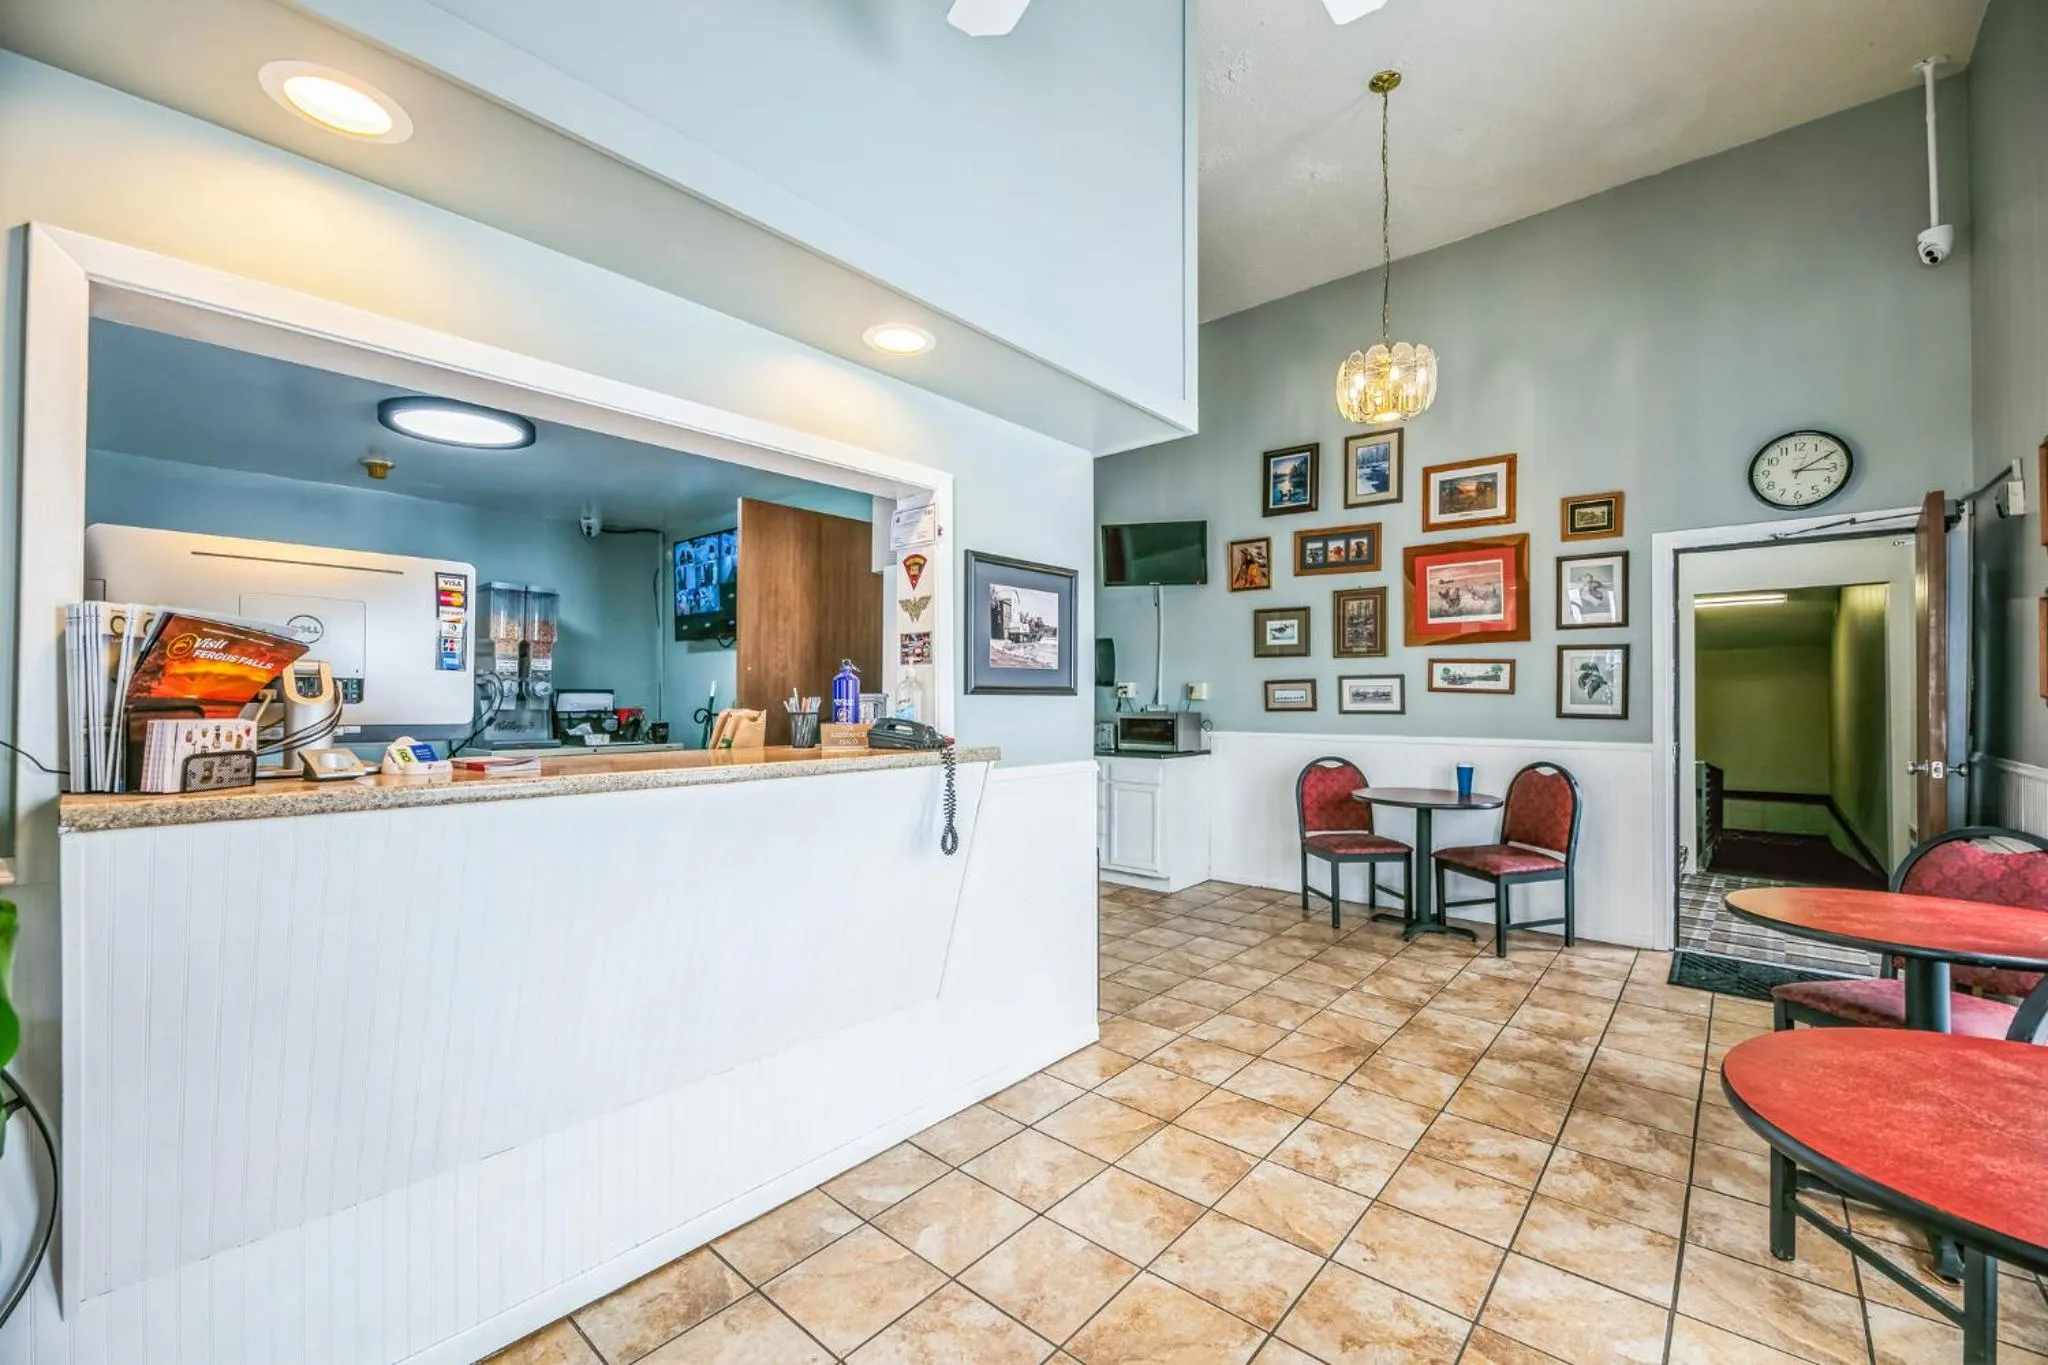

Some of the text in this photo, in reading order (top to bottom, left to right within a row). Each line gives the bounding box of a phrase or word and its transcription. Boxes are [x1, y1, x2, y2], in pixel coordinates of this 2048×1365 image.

[1780, 447, 1788, 456] 11
[1794, 442, 1806, 452] 12
[1767, 457, 1779, 466] 10
[1829, 463, 1837, 472] 3
[1762, 470, 1770, 479] 9
[1824, 476, 1831, 484] 4
[1766, 481, 1775, 490] 8
[1811, 485, 1820, 495] 5
[1779, 489, 1786, 498] 7
[1793, 490, 1803, 499] 6
[194, 638, 228, 649] Visit
[193, 649, 274, 669] FERGUS FALLS
